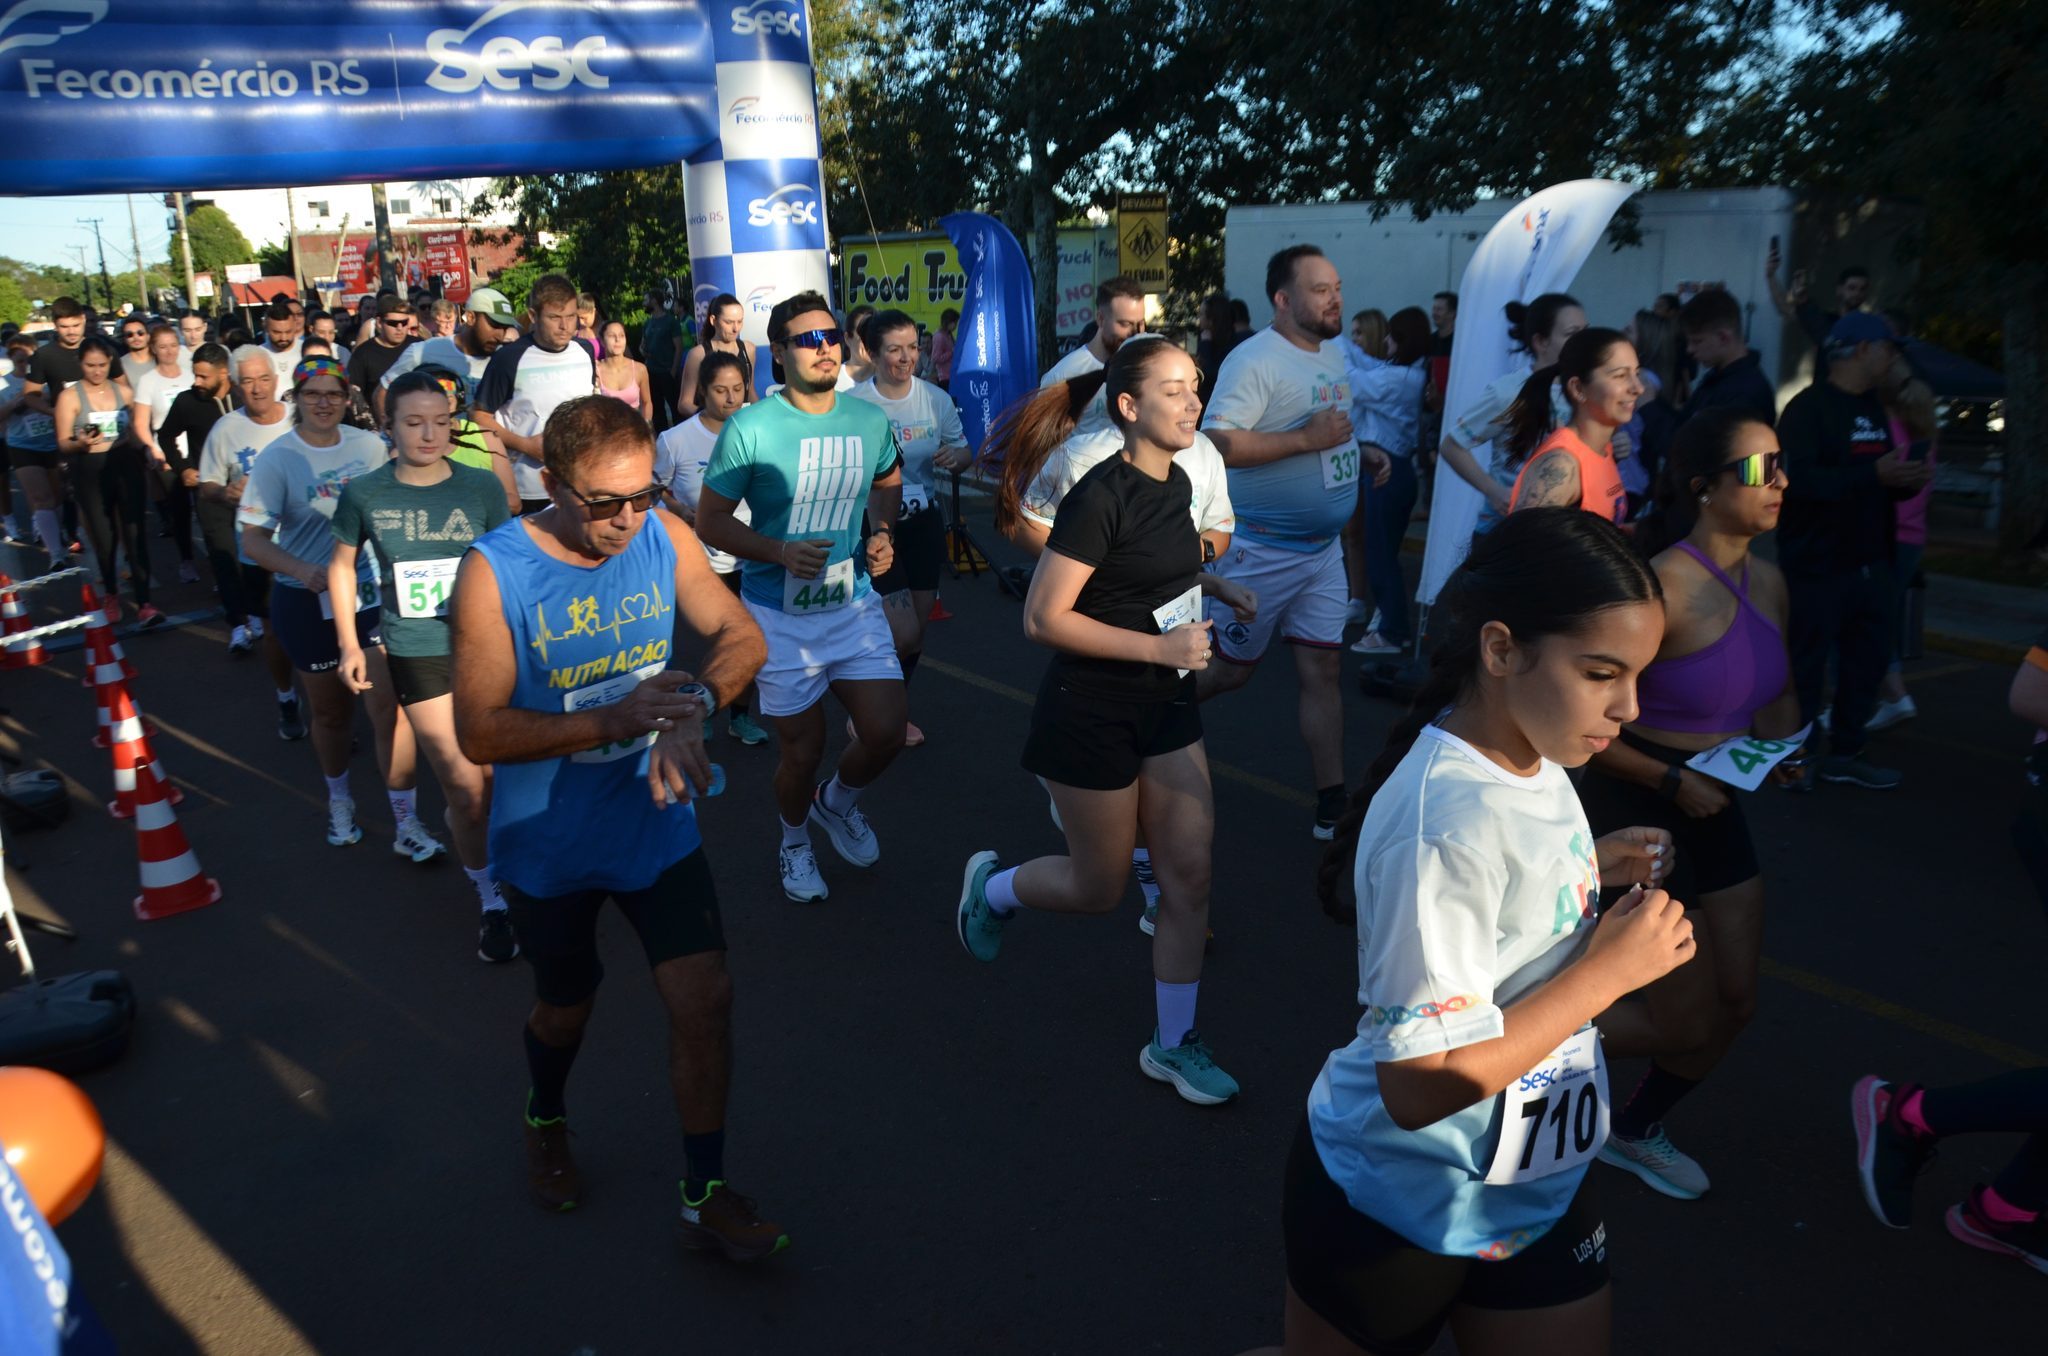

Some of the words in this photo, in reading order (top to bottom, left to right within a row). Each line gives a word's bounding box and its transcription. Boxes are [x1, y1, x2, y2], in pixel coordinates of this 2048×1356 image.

[731, 6, 802, 38] Sesc
[425, 29, 610, 94] Sesc
[20, 59, 299, 99] Fecomércio
[311, 60, 369, 97] RS
[736, 113, 802, 125] Fecoércio
[709, 211, 724, 223] RS
[748, 199, 817, 227] Sesc
[1121, 198, 1164, 210] DEVAGAR
[847, 251, 911, 304] Food
[923, 250, 967, 303] Tru
[1058, 307, 1093, 329] ETO
[976, 312, 987, 368] Sindicatos
[979, 380, 989, 396] RS
[798, 435, 863, 472] RUN
[792, 468, 864, 505] RUN
[372, 508, 475, 542] FILA
[787, 499, 856, 534] RUN
[793, 579, 846, 610] 444
[549, 654, 612, 688] NUTRI
[612, 638, 668, 674] AÇÃO
[1520, 1067, 1557, 1092] Sesc
[1518, 1082, 1598, 1171] 710
[1573, 1238, 1594, 1263] LOS
